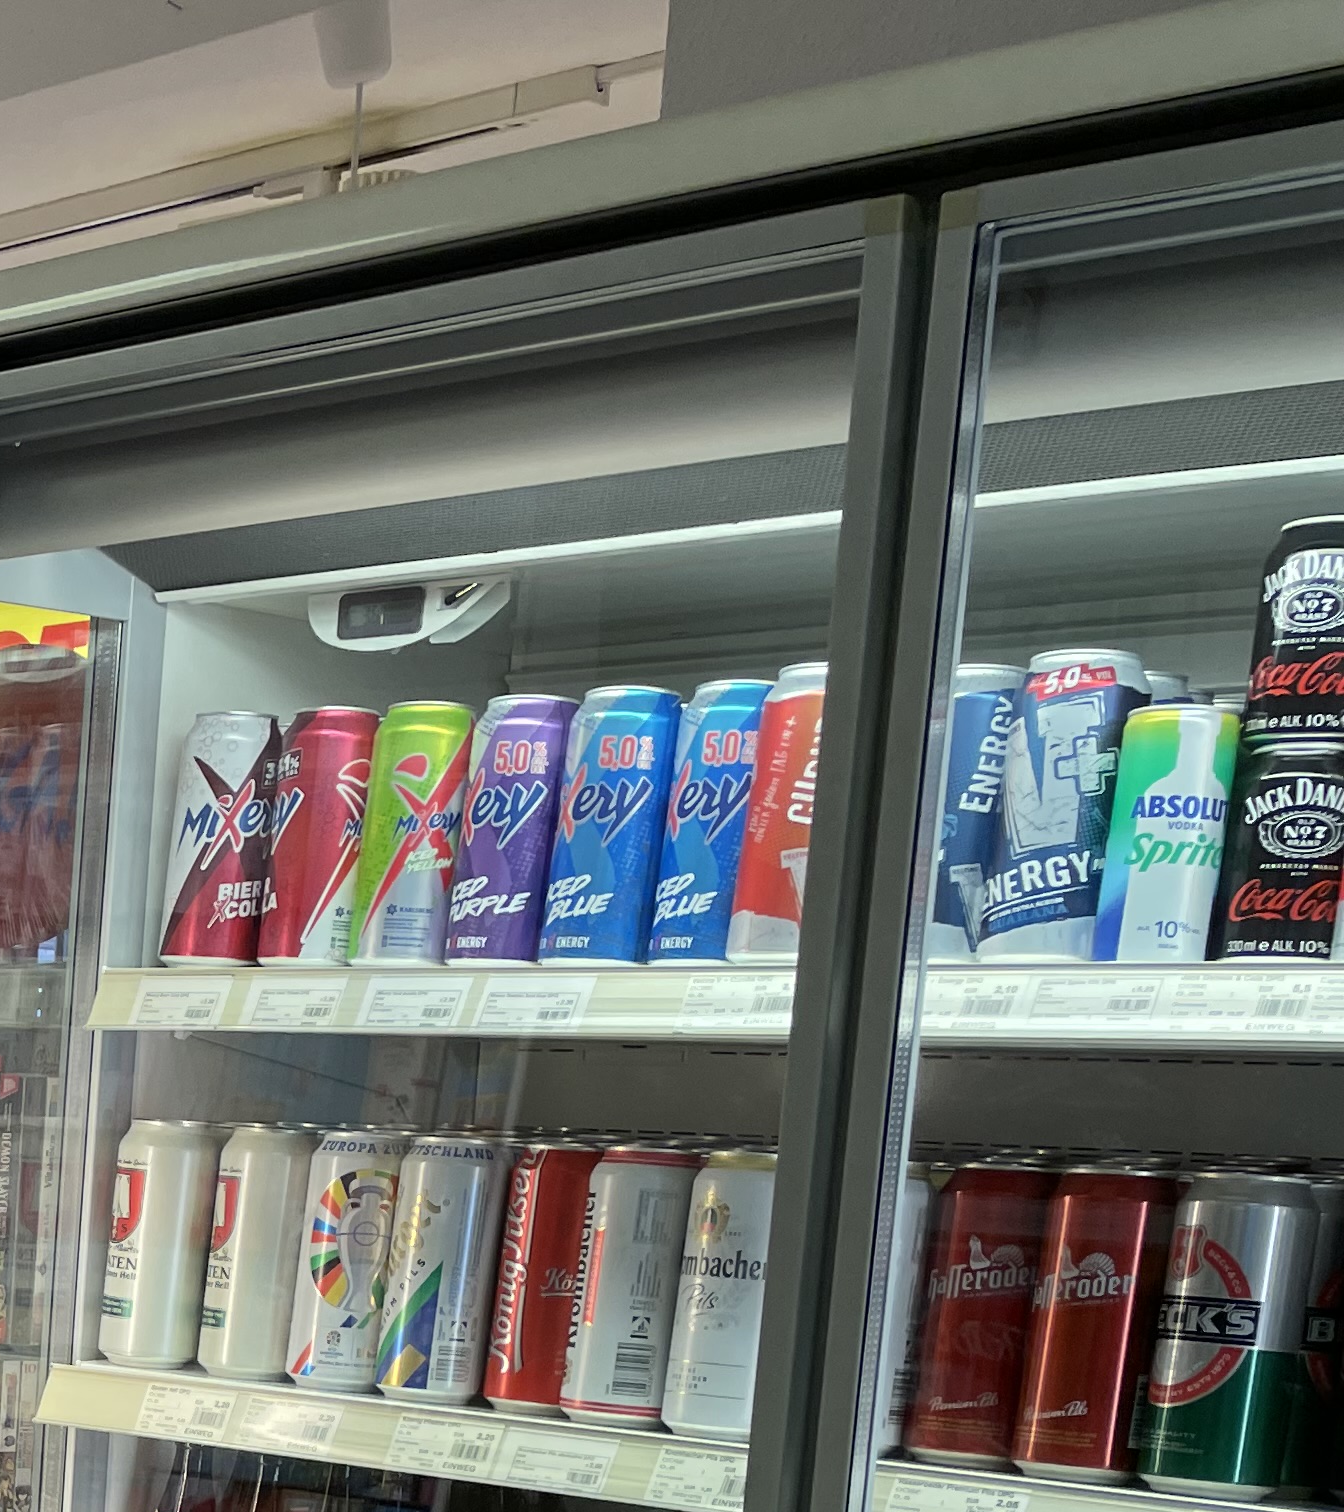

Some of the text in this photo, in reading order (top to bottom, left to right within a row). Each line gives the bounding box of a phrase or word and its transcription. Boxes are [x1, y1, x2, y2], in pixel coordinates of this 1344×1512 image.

[1264, 563, 1302, 602] JACK
[494, 741, 531, 775] 5,0
[600, 736, 636, 771] 5,0
[702, 731, 740, 765] 5,0
[1245, 785, 1292, 824] JACK
[1168, 822, 1203, 832] VODKA
[983, 850, 1092, 909] ENERGY
[547, 893, 614, 927] BLUE
[653, 892, 718, 927] BLUE
[457, 936, 488, 949] ENERGY
[555, 935, 590, 949] ENERGY
[660, 935, 694, 949] ENERGY
[566, 1190, 598, 1349] Krombacher
[683, 1283, 719, 1310] Pils
